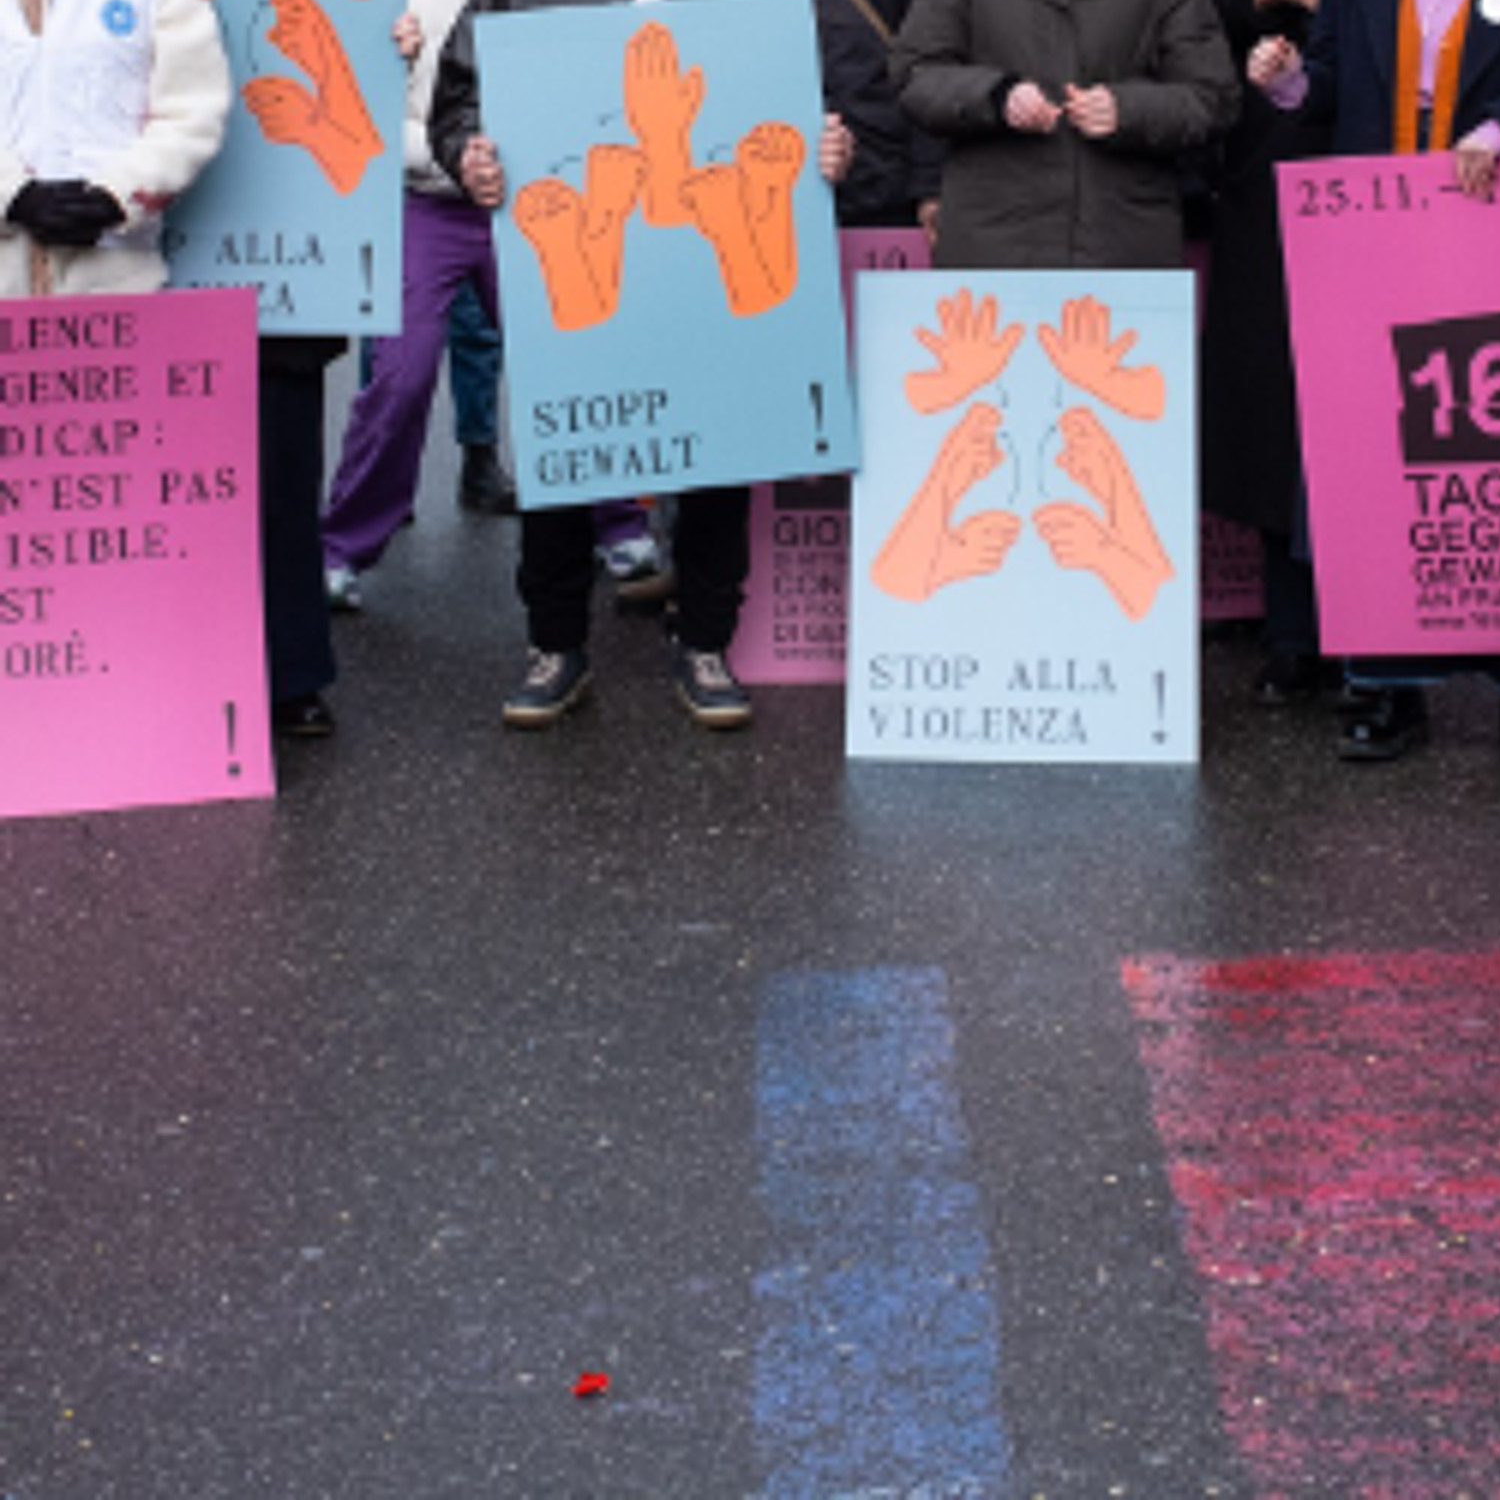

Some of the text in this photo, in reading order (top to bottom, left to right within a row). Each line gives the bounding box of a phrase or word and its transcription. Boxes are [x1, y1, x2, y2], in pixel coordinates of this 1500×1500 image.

[216, 232, 325, 266] ALLA
[0, 361, 221, 405] GENRE ET
[532, 388, 668, 438] STOPP
[536, 432, 700, 487] GEWALT
[160, 466, 238, 504] PAS
[774, 515, 851, 547] GIO
[868, 653, 980, 692] STOP
[1007, 658, 1118, 693] ALLA
[868, 705, 1088, 746] VIOLENZA
